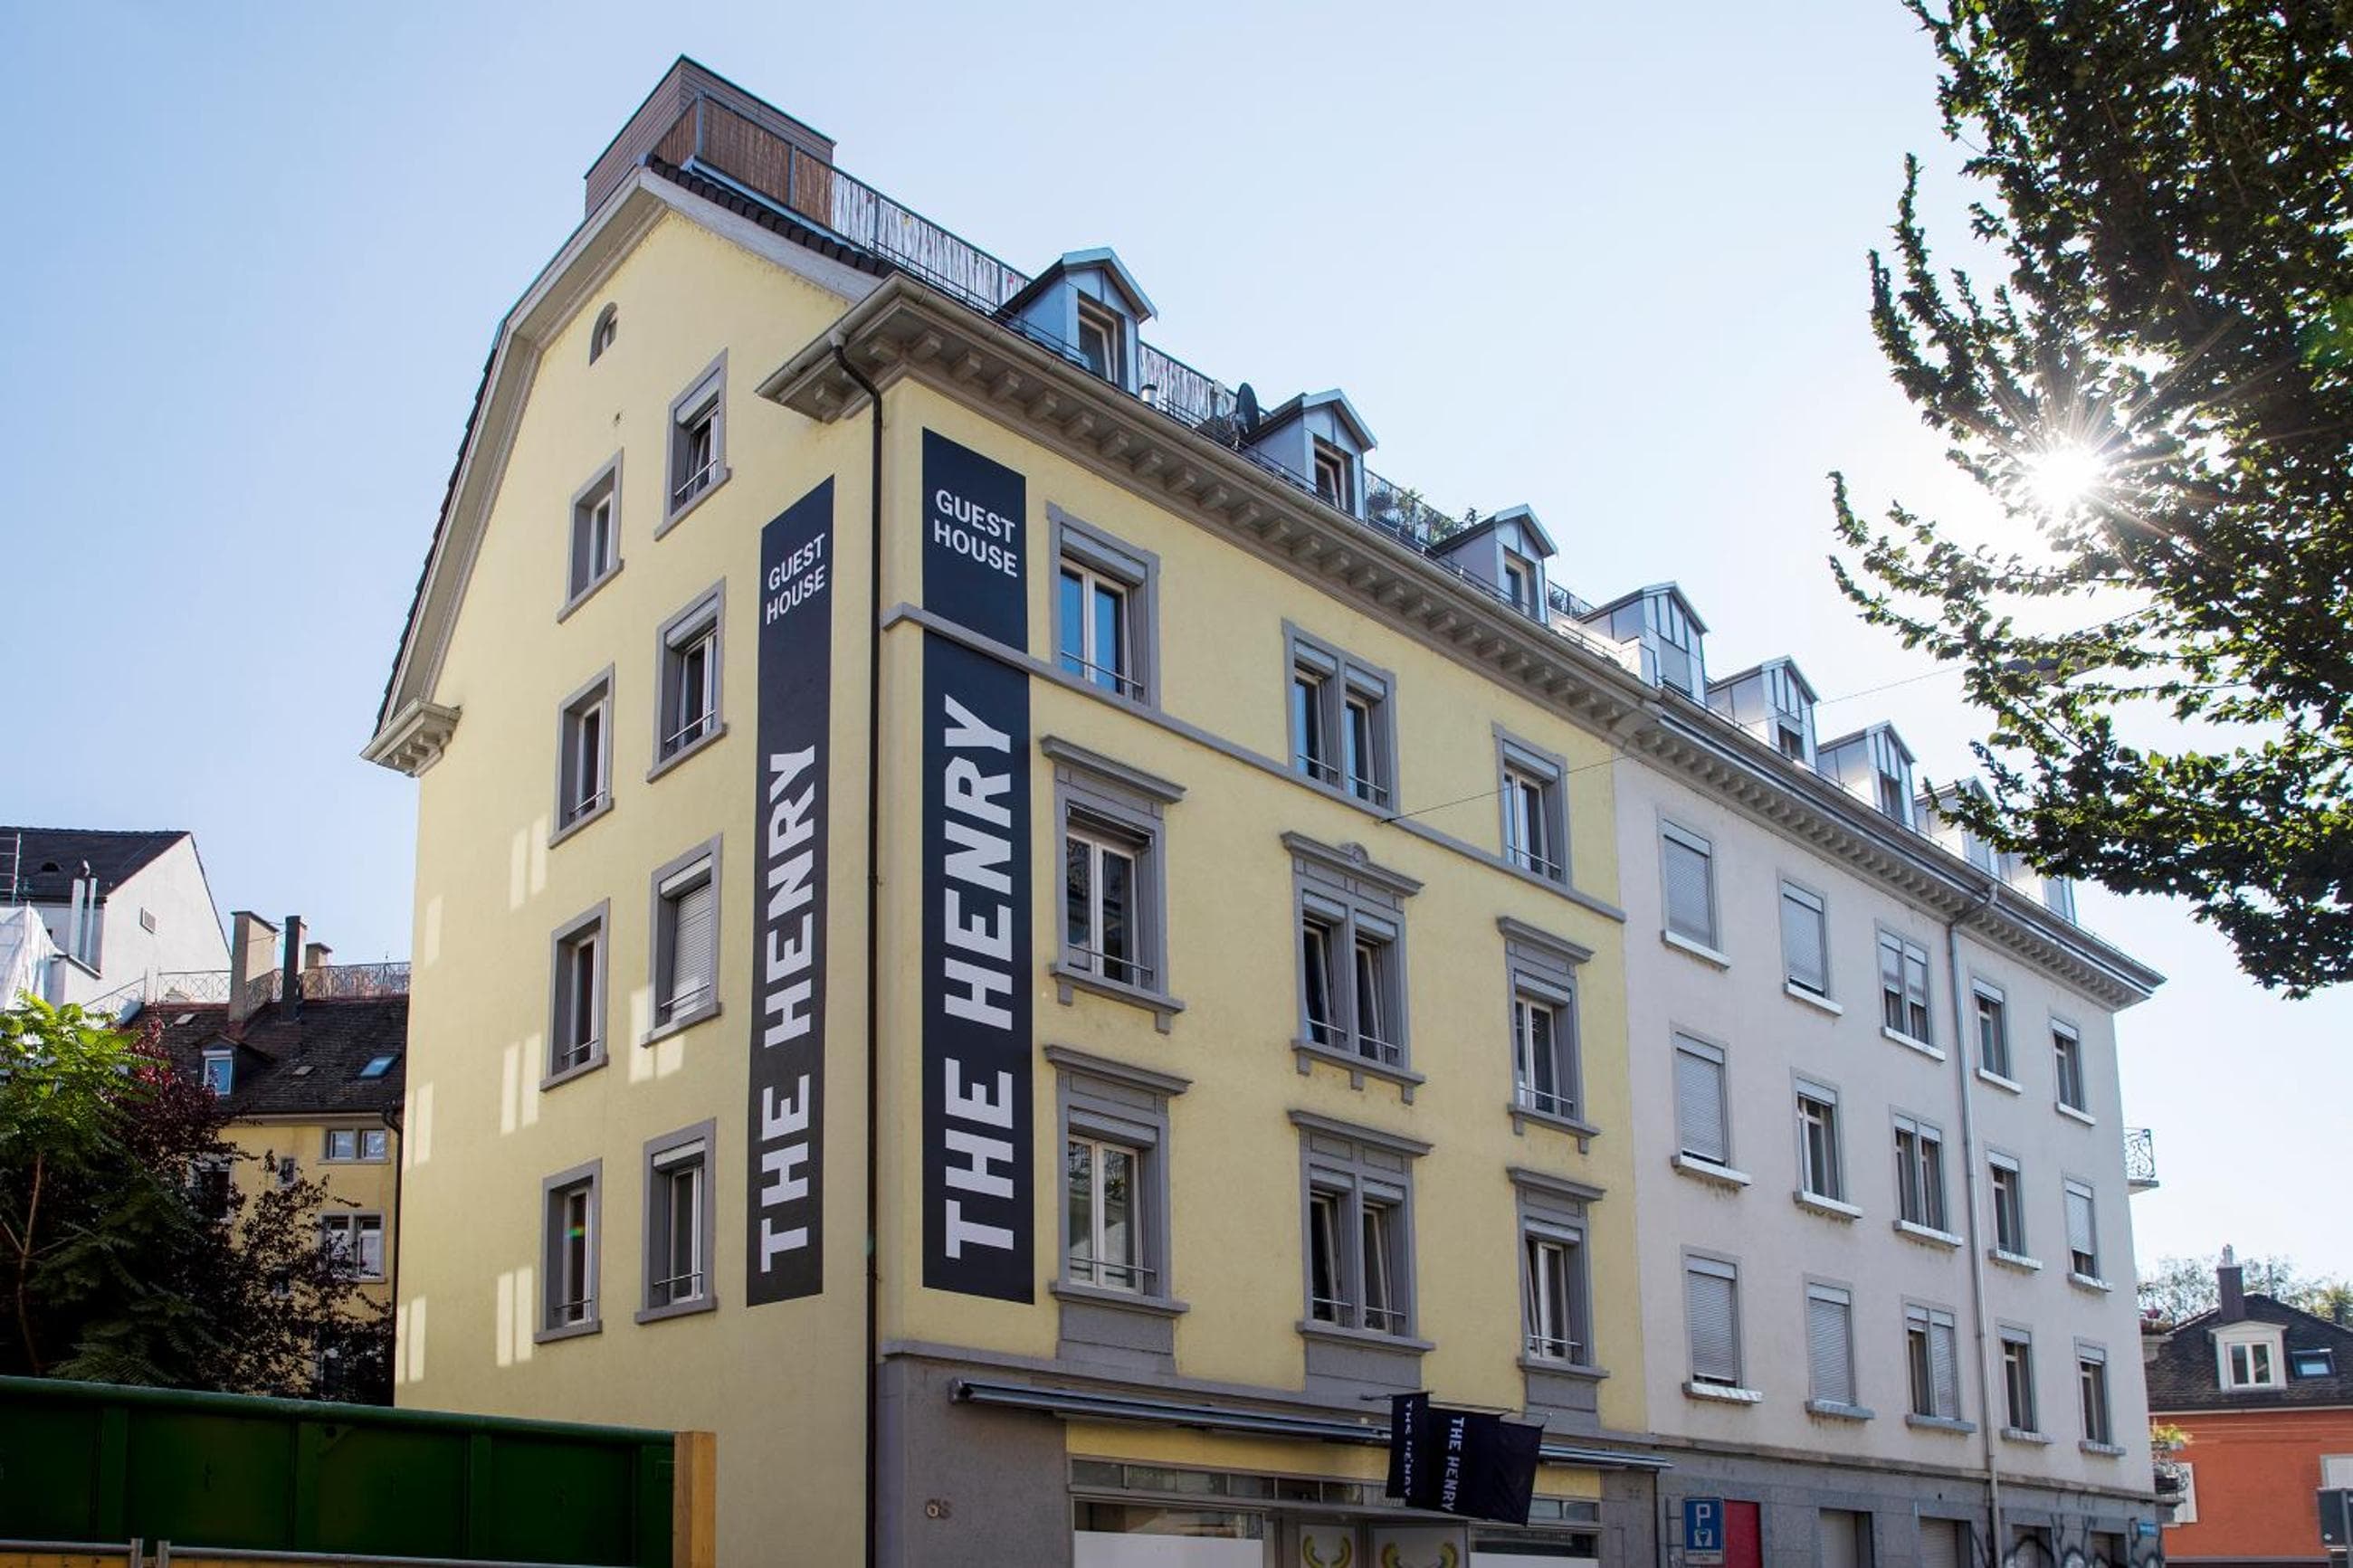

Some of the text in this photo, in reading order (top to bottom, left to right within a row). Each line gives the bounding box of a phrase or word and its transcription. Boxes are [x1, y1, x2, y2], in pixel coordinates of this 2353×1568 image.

[936, 489, 1015, 543] GUEST
[768, 533, 825, 591] GUEST
[935, 518, 1017, 578] HOUSE
[767, 565, 825, 625] HOUSE
[946, 694, 1014, 1259] THE HENRY
[761, 745, 814, 1272] THE HENRY
[1441, 1417, 1465, 1512] THE HENRY
[1696, 1504, 1710, 1527] P
